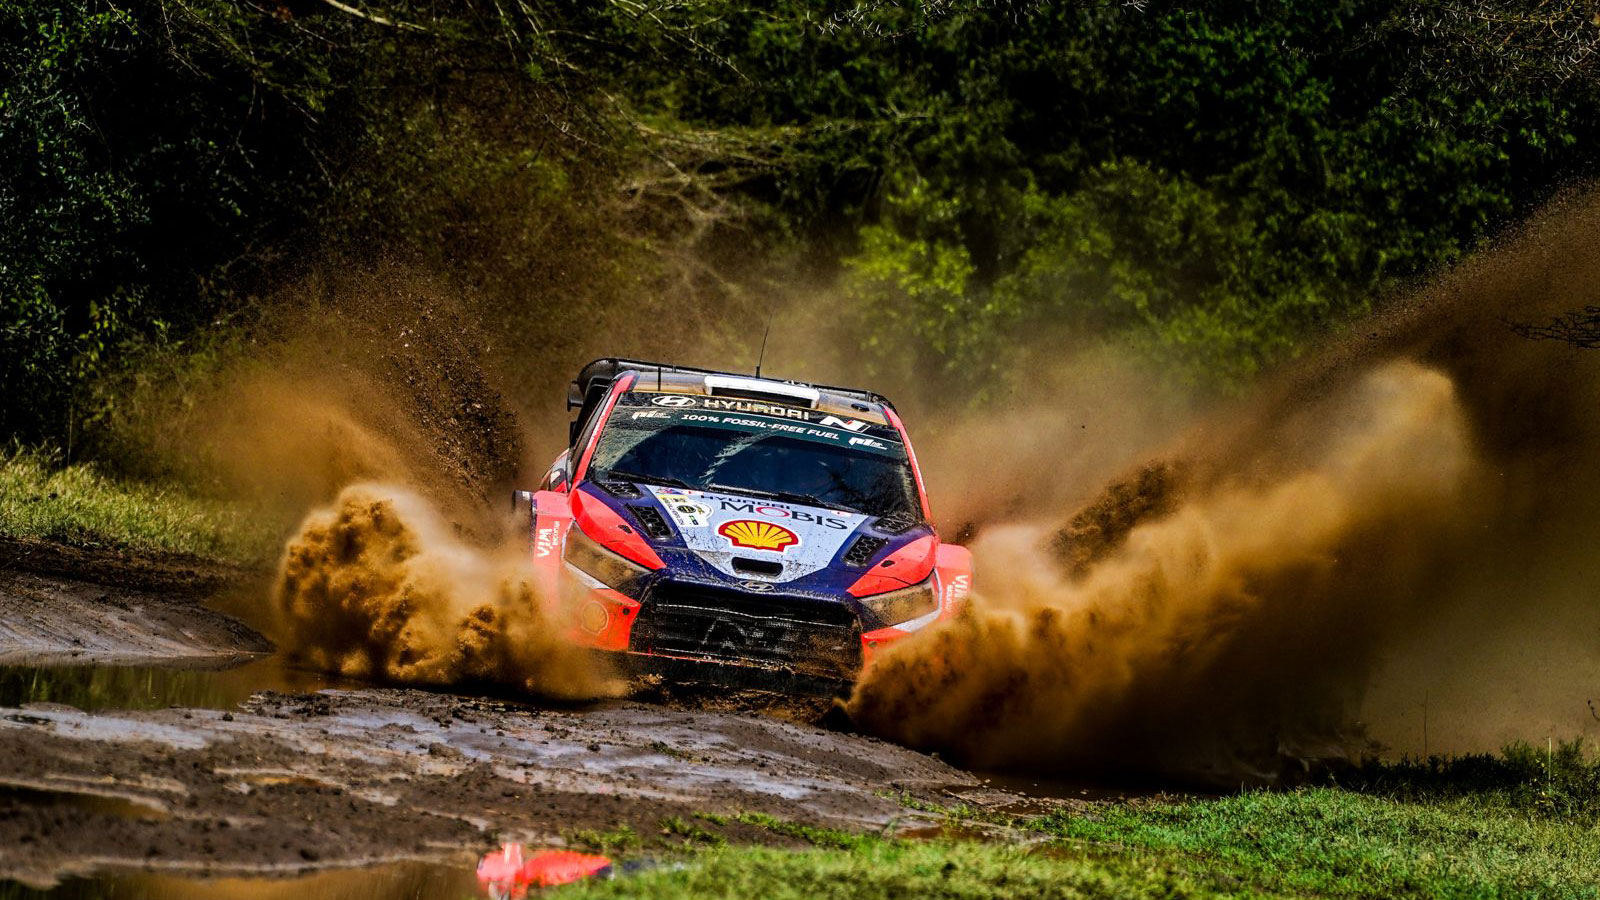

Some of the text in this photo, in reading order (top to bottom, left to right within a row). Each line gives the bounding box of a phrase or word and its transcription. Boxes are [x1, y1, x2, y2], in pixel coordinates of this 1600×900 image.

[704, 399, 810, 420] HYUNDAI
[681, 413, 720, 423] 100%
[722, 417, 807, 435] FOSSIL-FREE
[807, 428, 840, 440] FUEL
[700, 494, 790, 510] HYUNDAI
[720, 501, 848, 530] MOBIS
